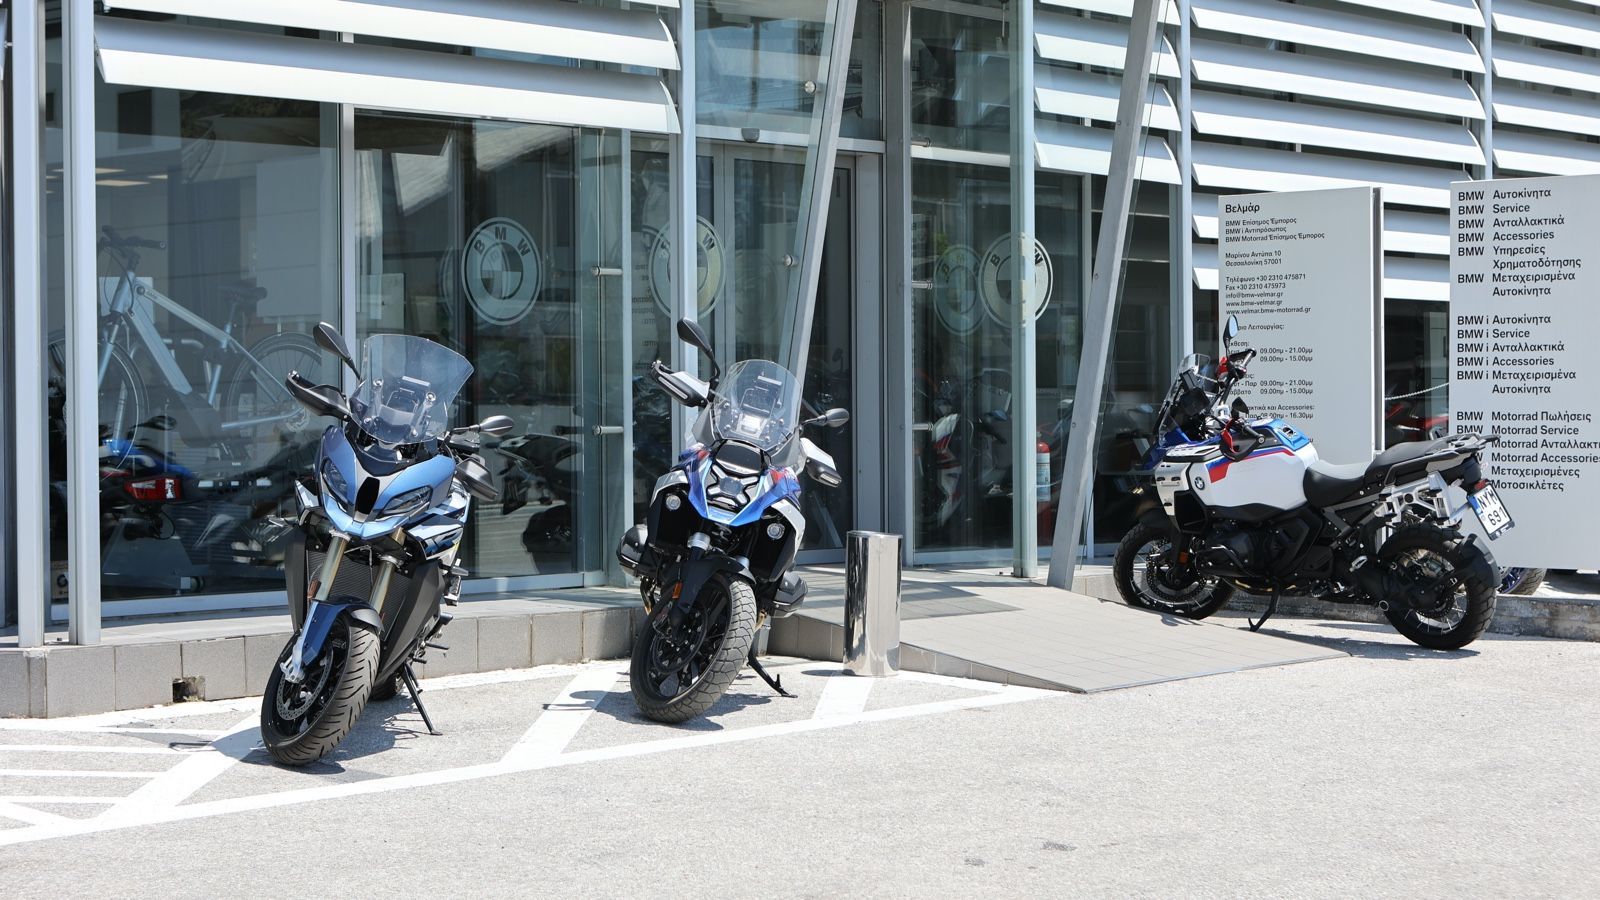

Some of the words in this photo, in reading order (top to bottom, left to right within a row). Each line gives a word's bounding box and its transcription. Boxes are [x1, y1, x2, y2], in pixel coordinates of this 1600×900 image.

[1458, 191, 1484, 201] BMW
[1493, 188, 1551, 199] Αυτοκίνητα
[1225, 202, 1260, 214] Βελμάρ
[1458, 205, 1484, 215] BMW
[1493, 203, 1530, 213] Service
[1458, 219, 1484, 229] BMW
[1493, 214, 1565, 227] Ανταλλακτικά
[1458, 233, 1484, 242] BMW
[1493, 230, 1555, 241] Accessories
[1458, 247, 1484, 256] BMW
[1493, 244, 1545, 256] Υπηρεσίες
[1225, 259, 1263, 267] Θεσσαλονίκη
[1493, 257, 1581, 270] Χρηματοδότησης
[1225, 276, 1255, 284] Τηλέφωνο
[1457, 274, 1484, 283] BMW
[1492, 270, 1576, 283] Μεταχειρισμένα
[1492, 285, 1551, 297] Αυτοκίνητα
[1457, 315, 1484, 325] BMW
[1492, 313, 1551, 325] Αυτοκίνητα
[1457, 329, 1484, 339] BMW
[1492, 328, 1530, 338] Service
[1457, 343, 1484, 353] BMW
[1492, 340, 1565, 352] Ανταλλακτικά
[1457, 357, 1484, 366] BMW
[1492, 356, 1554, 366] Accessories
[1457, 370, 1484, 380] BMW
[1492, 369, 1576, 381] Μεταχειρισμένα
[1492, 383, 1551, 395] Αυτοκίνητα
[1456, 411, 1484, 421] BMW
[1491, 411, 1538, 421] Motorrad
[1541, 410, 1592, 422] Πωλήσεις
[1456, 425, 1484, 434] BMW
[1491, 425, 1538, 435] Motorrad
[1540, 425, 1579, 435] Service
[1491, 439, 1538, 448] Motorrad
[1491, 452, 1538, 462] Motorrad
[1491, 465, 1580, 478] Μεταχειρισμένες
[1491, 480, 1564, 492] Μοτοσικλέτες
[1487, 506, 1507, 526] 691
